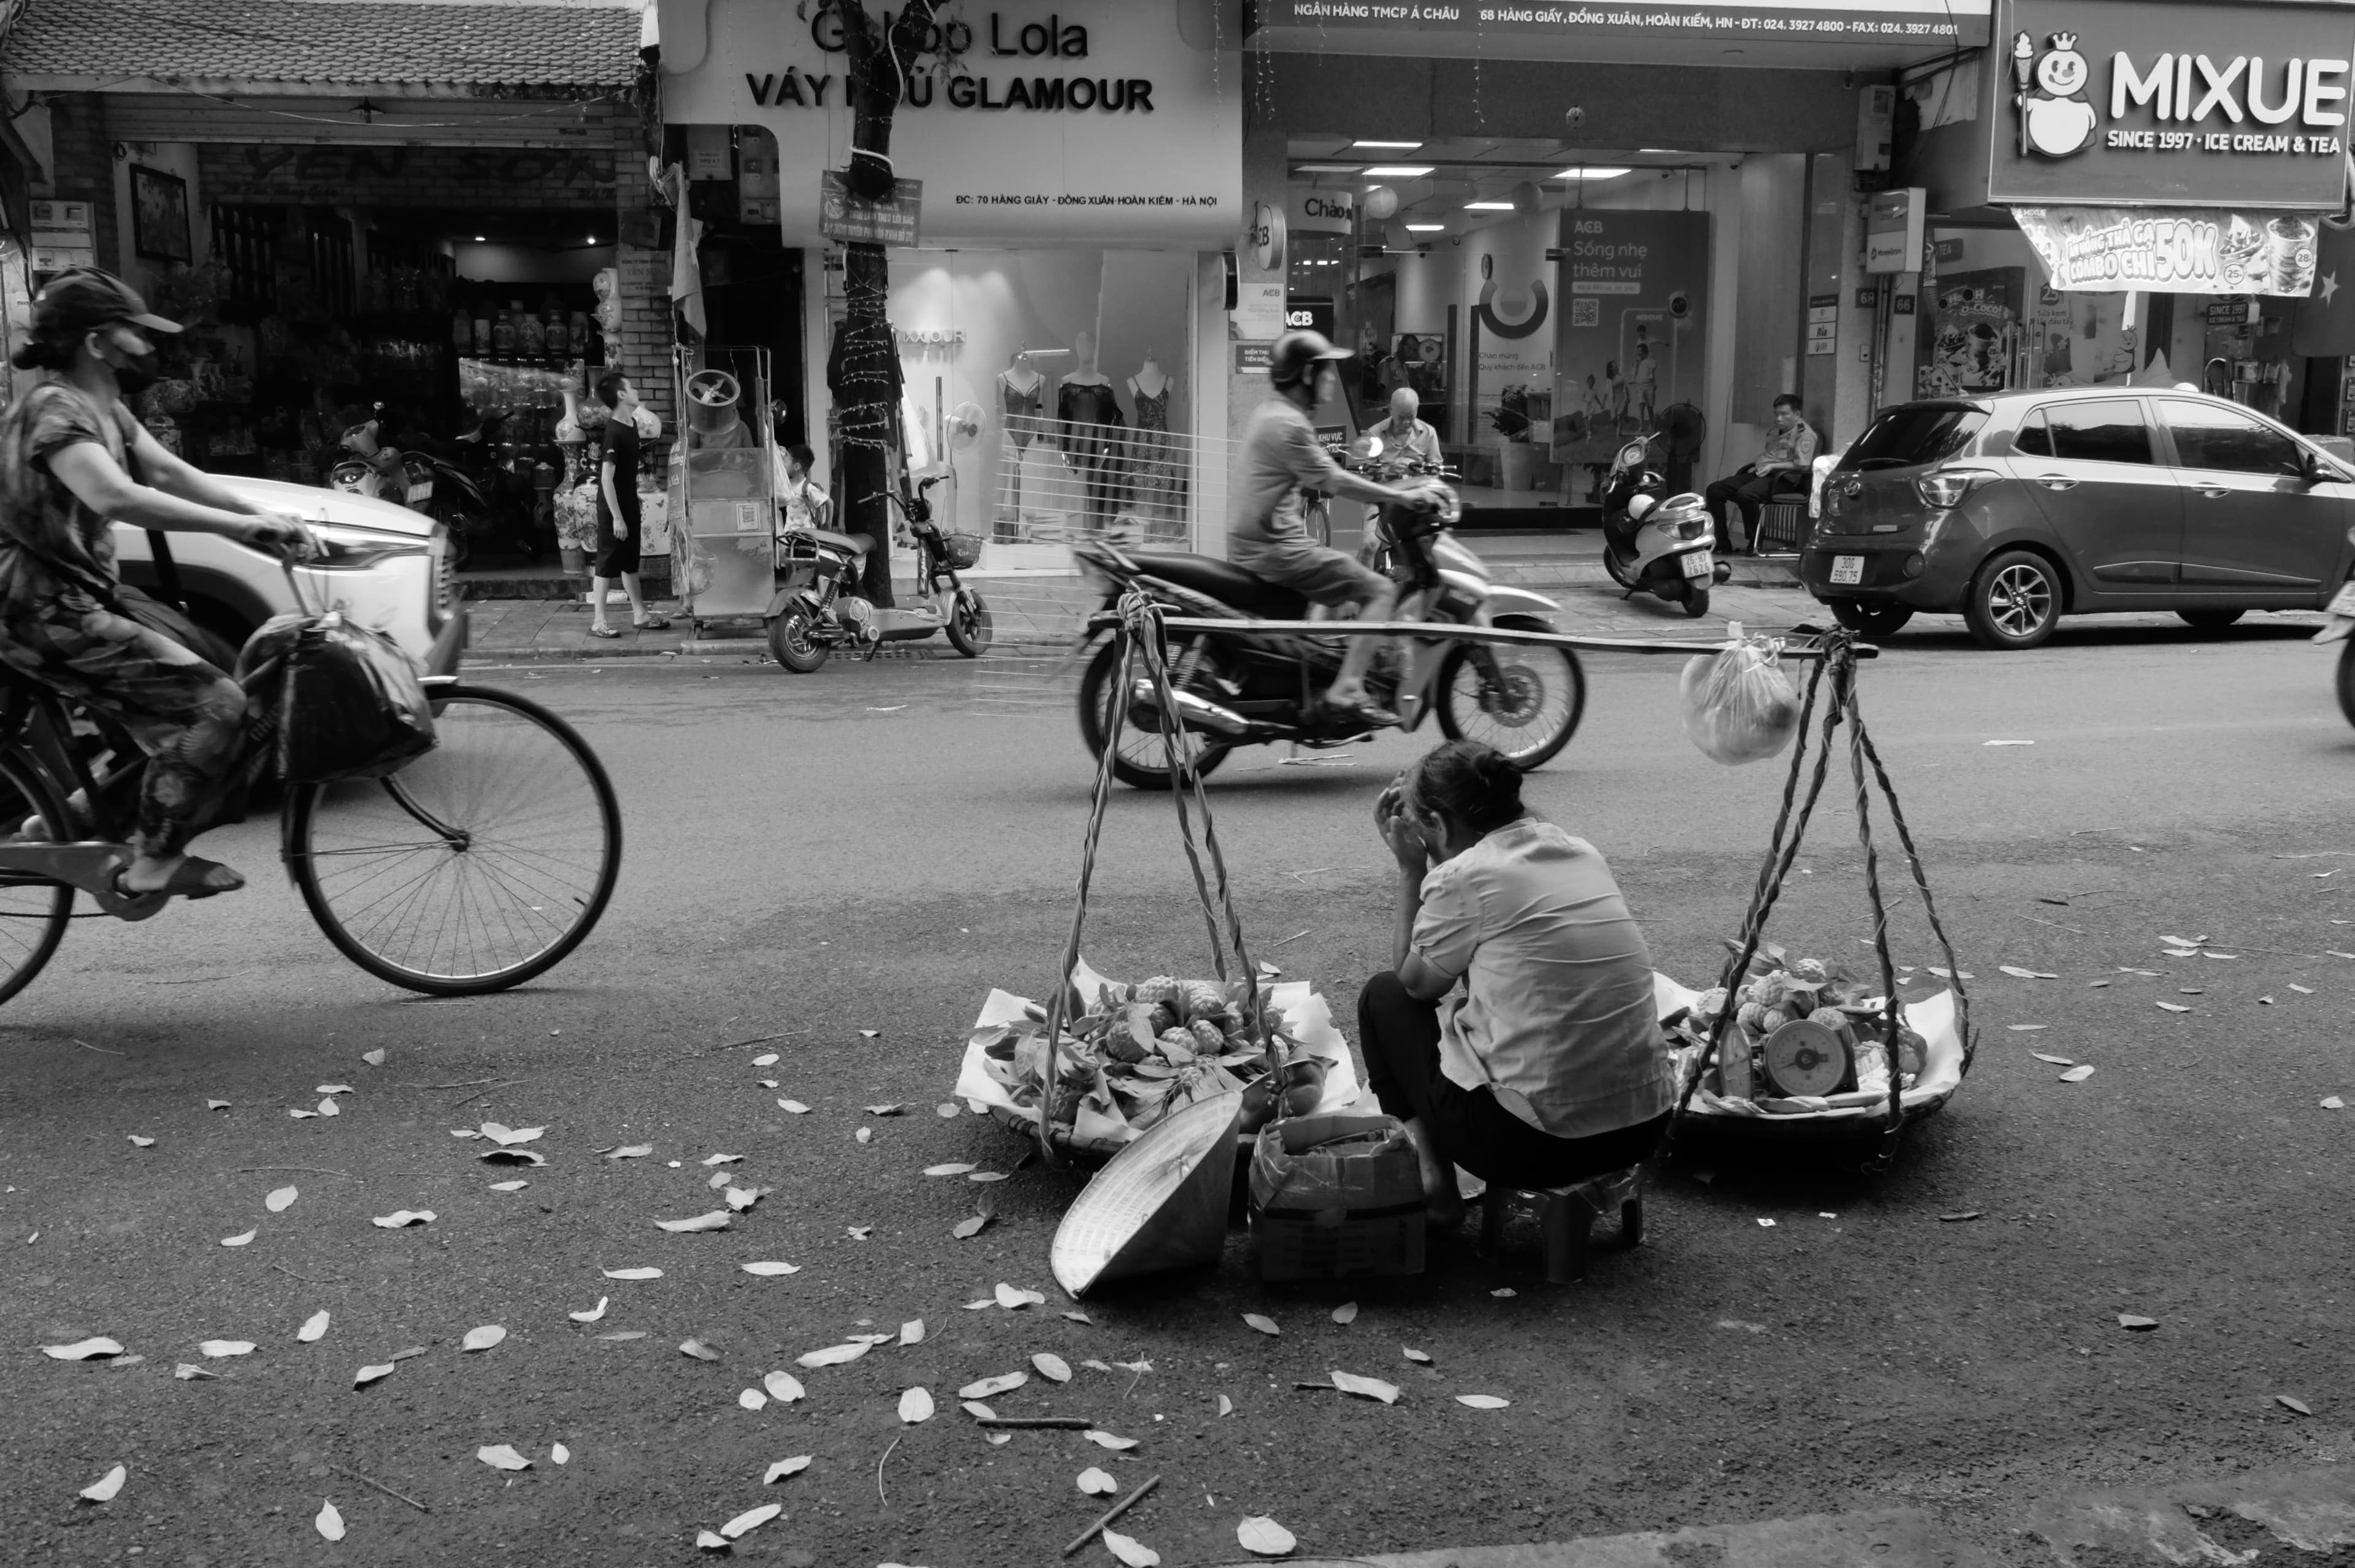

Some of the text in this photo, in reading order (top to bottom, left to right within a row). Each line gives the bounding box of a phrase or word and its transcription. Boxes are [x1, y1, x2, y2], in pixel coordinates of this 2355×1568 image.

[1294, 2, 1460, 20] NGÂN HÀNG TMCP Á CHÂU
[1480, 10, 1495, 20] 68
[1498, 7, 1533, 22] HÀNG
[1645, 12, 1680, 26] HOÀN
[1682, 13, 1713, 29] KIẾM,
[1716, 17, 1733, 28] HN
[1741, 18, 1761, 29] ĐT:
[1764, 18, 1786, 30] 024.
[1789, 20, 1815, 31] 3927
[1817, 21, 1844, 32] 4800
[1853, 21, 1878, 33] FAX:
[1880, 23, 1903, 34] 024.
[1905, 23, 1930, 34] 3927
[1932, 25, 1958, 35] 4801
[991, 12, 1089, 57] Lola
[745, 66, 830, 107] VÁY
[948, 75, 1154, 111] GLAMOUR
[2111, 51, 2349, 126] MIXUE
[2107, 130, 2341, 153] SINCE 1997 ICE CREAM & TEA
[955, 194, 974, 204] ĐC:
[976, 195, 989, 204] 70
[991, 193, 1022, 205] HÀNG
[1057, 194, 1087, 205] ĐỒNG
[1148, 195, 1173, 205] KIẾM
[1182, 195, 1197, 205] HÀ
[1200, 196, 1217, 207] NỘI
[1574, 221, 1603, 234] ACB
[1574, 240, 1614, 260] Sống
[1939, 243, 1952, 256] TEA
[1572, 262, 1615, 278] thêm
[1860, 292, 1875, 305] 68
[1896, 298, 1910, 311] 66
[2208, 305, 2230, 315] SINCE
